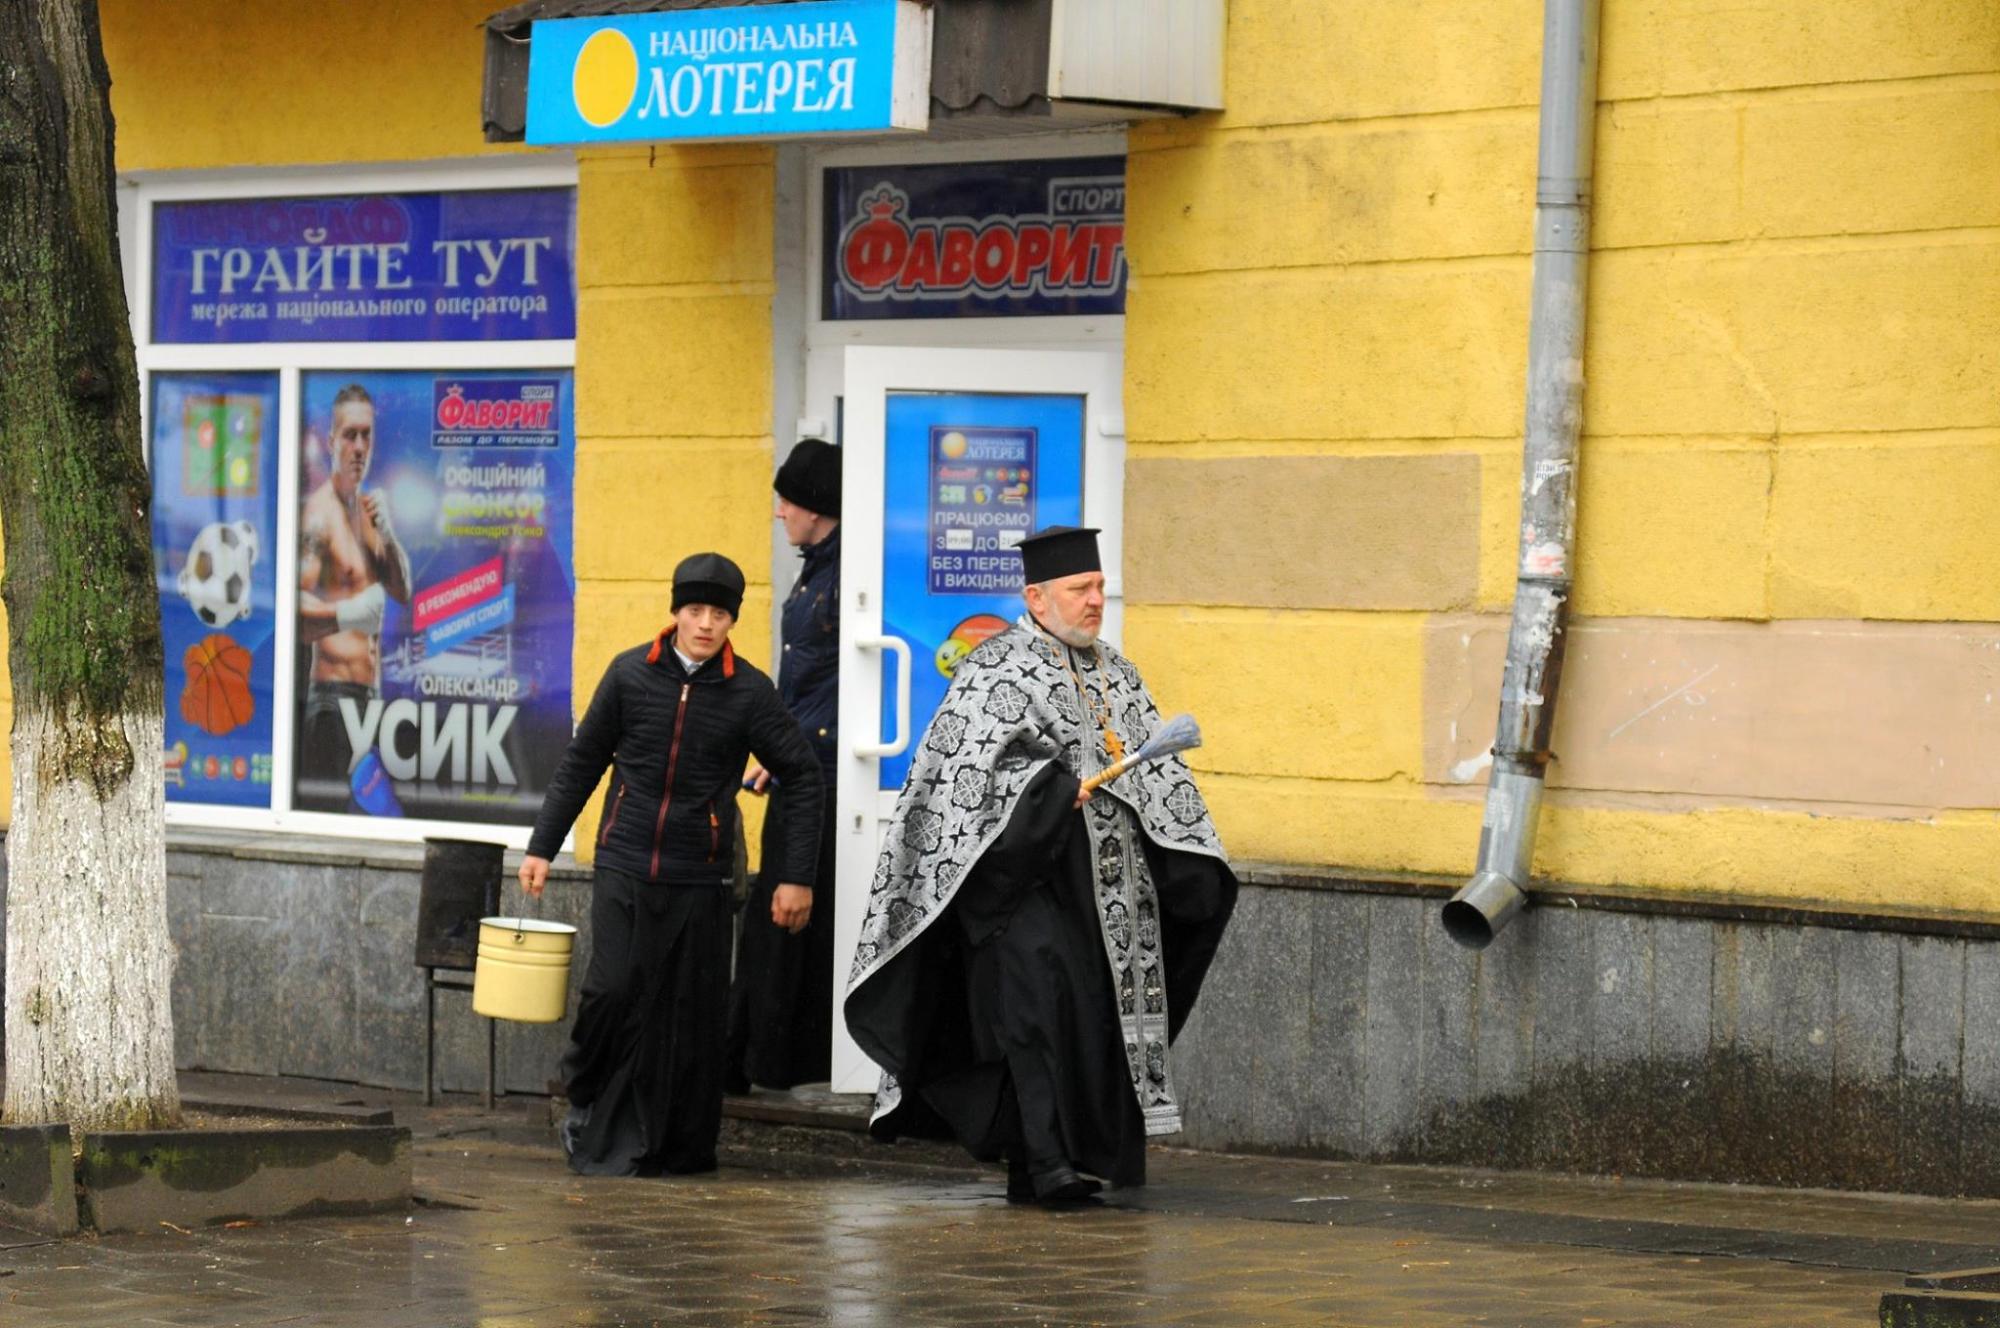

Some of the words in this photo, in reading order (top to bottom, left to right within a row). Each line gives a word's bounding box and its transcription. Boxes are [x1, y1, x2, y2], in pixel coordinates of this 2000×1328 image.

[649, 22, 858, 60] НАЦІОНАЛЬНА
[638, 57, 857, 118] ЛОТЕРЕЯ
[1055, 188, 1125, 212] СПОРТ
[190, 228, 412, 294] ГРАЙТЕ
[433, 237, 551, 288] ТУТ
[844, 217, 1125, 288] ФАВОРИТ
[191, 304, 267, 326] мережа
[276, 293, 426, 325] національного
[435, 293, 547, 318] оператора
[438, 394, 553, 429] ФАВОРИТ
[965, 447, 1025, 460] ЛОТЕРЕЯ
[935, 512, 1030, 527] ПРАЦЮЄМО
[974, 537, 998, 552] ДО
[932, 557, 963, 570] БЕЗ
[967, 557, 1025, 570] ПЕРЕР
[945, 574, 1025, 589] ВИХІДНИХ
[421, 674, 519, 702] ОЛЕКСАНДР
[339, 698, 518, 785] УСИК
